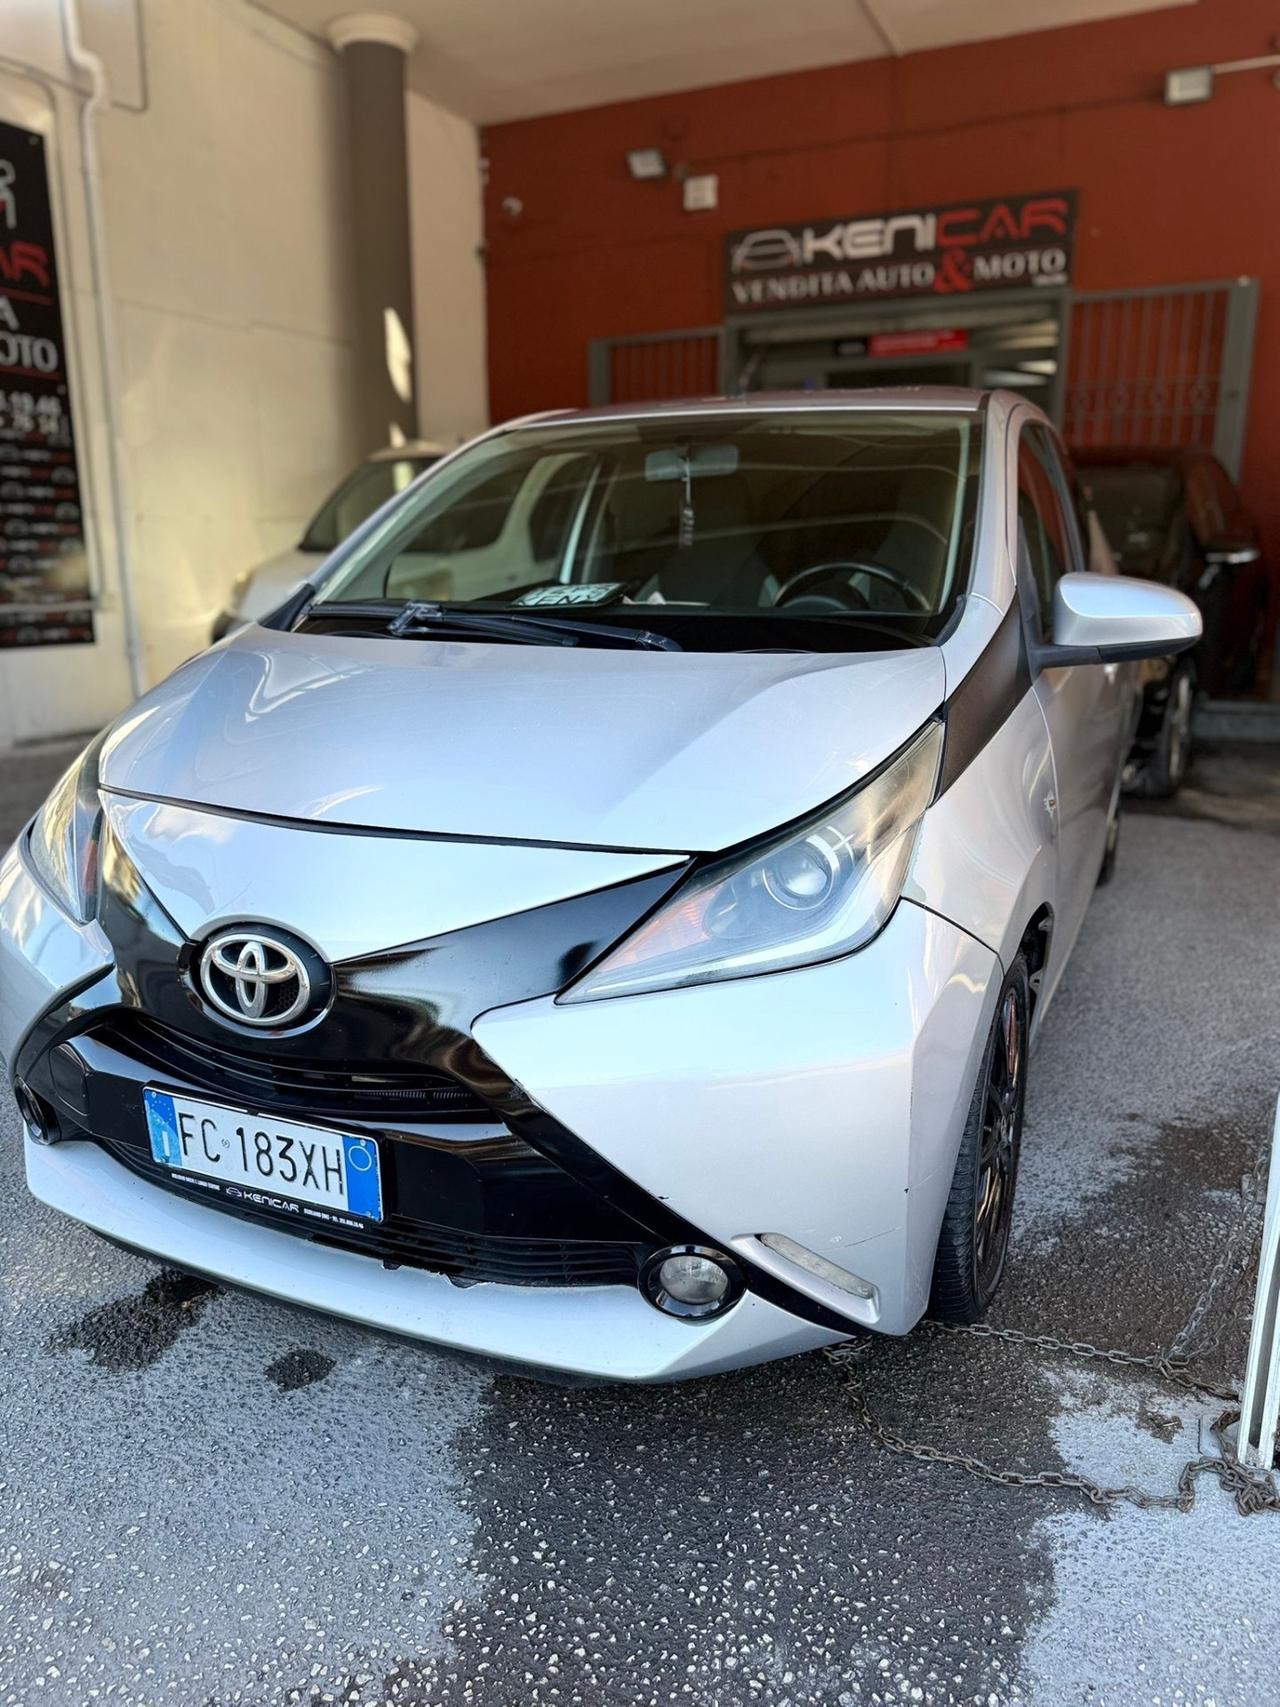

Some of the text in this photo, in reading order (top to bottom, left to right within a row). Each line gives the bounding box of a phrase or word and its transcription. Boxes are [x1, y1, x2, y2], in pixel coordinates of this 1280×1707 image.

[802, 199, 1068, 264] KENICAR
[732, 270, 854, 304] VENDITA
[855, 261, 936, 292] AUTO
[933, 248, 975, 293] &
[973, 247, 1068, 280] MOTO
[178, 1112, 221, 1163] FC
[235, 1126, 345, 1195] 183XH
[243, 1191, 300, 1214] KENICAR
